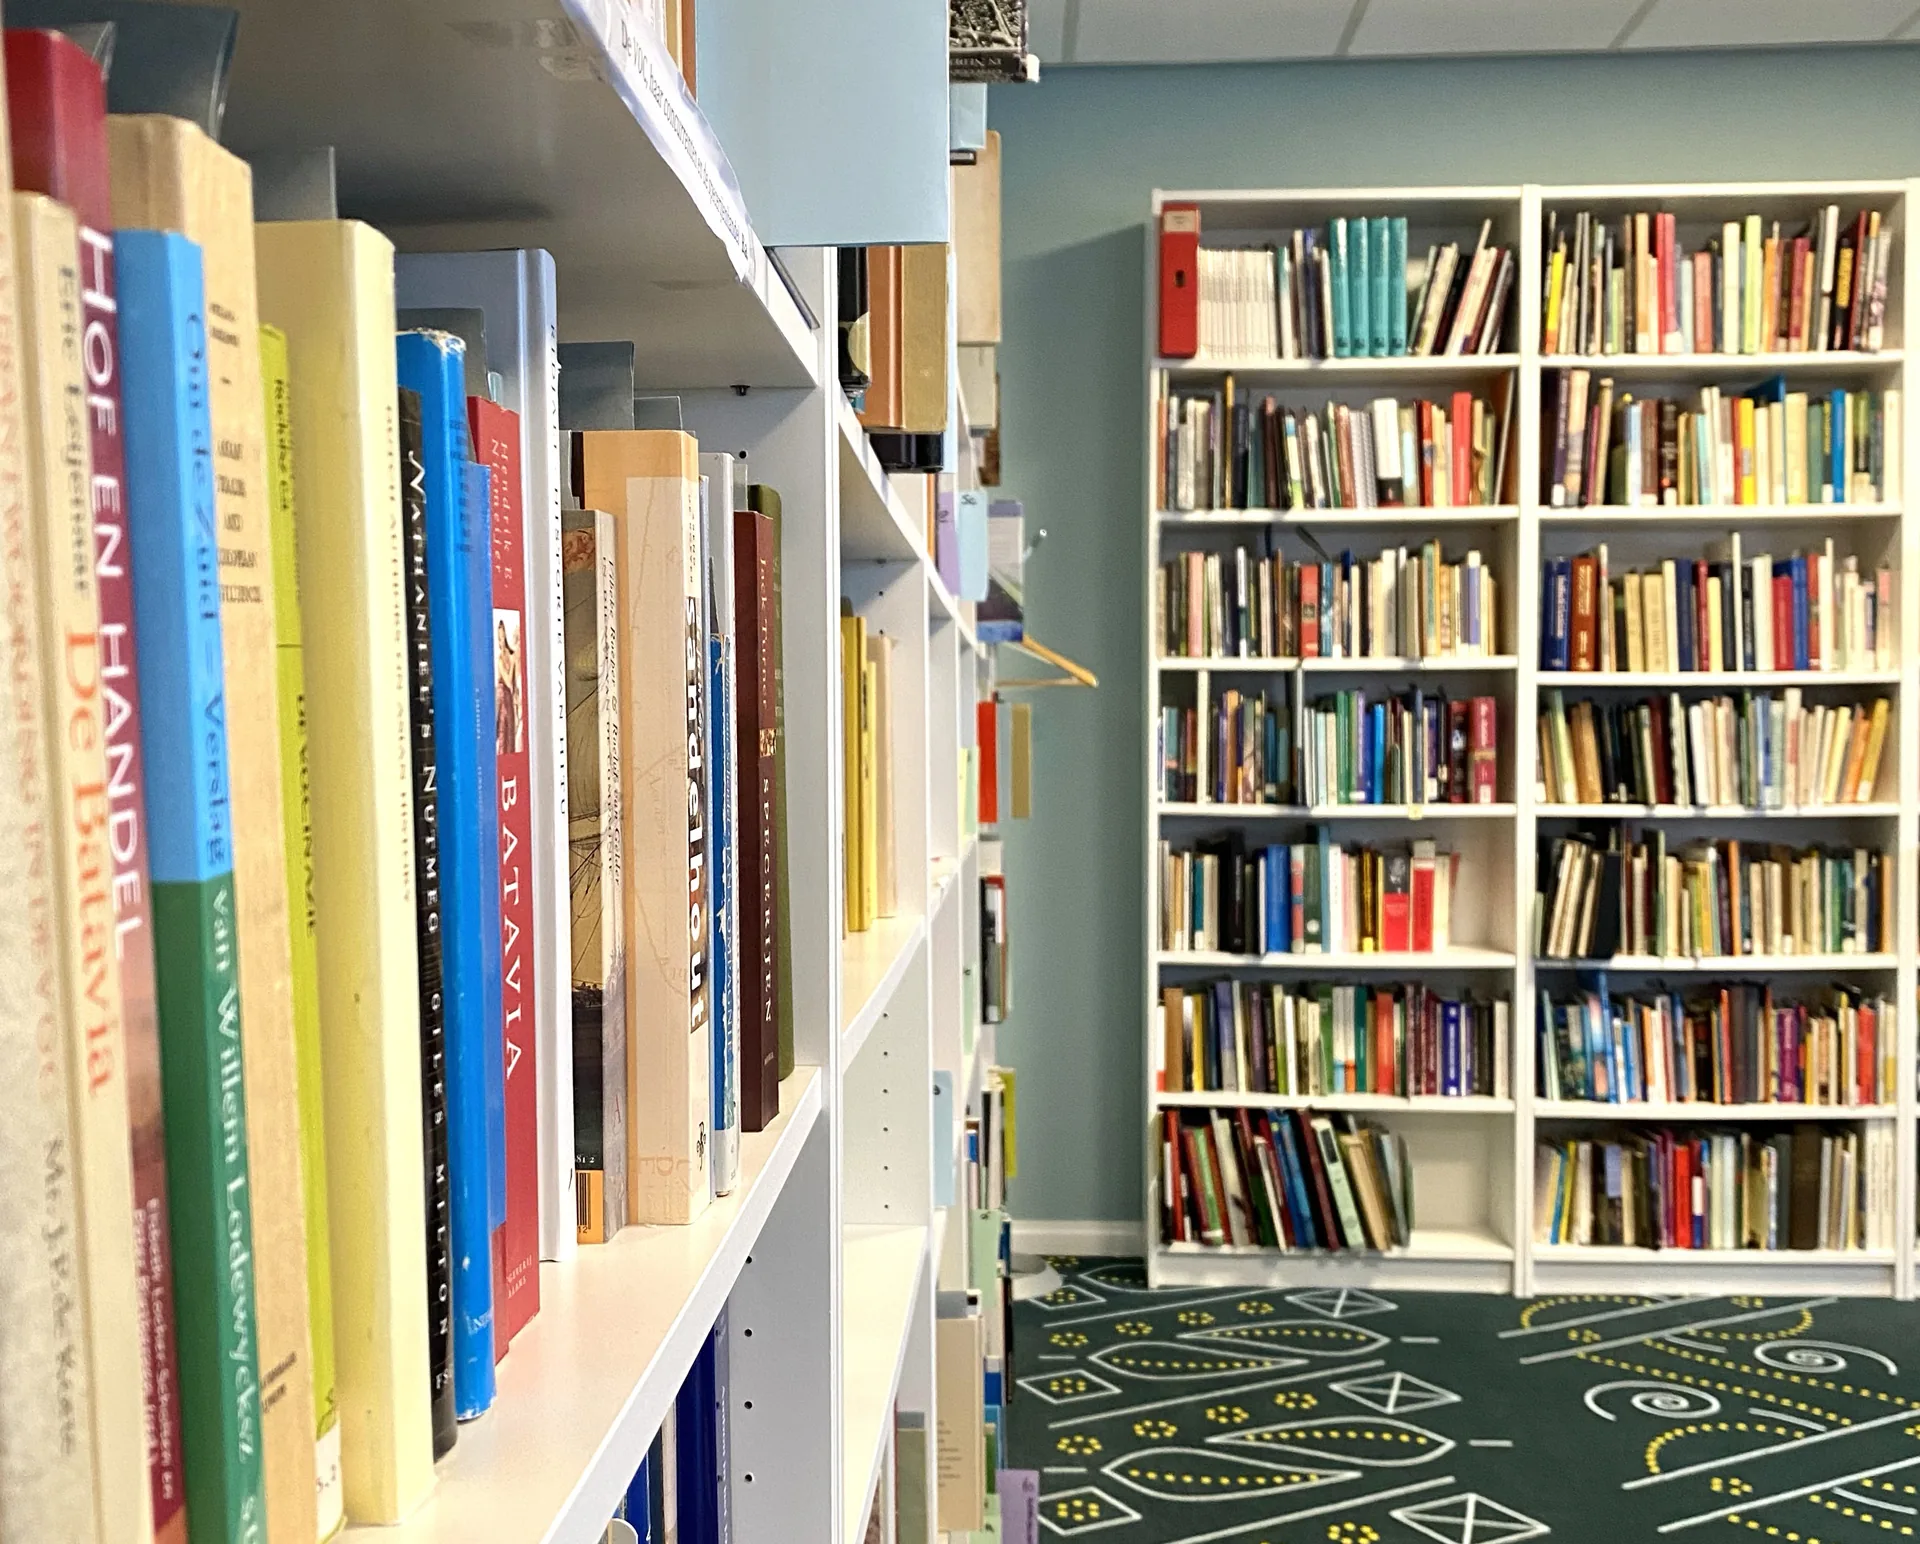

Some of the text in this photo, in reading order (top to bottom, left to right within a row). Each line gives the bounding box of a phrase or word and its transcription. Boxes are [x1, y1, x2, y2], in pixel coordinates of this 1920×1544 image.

[621, 19, 631, 56] De
[664, 98, 698, 168] concurrenten
[500, 442, 514, 552] Hendrik
[759, 558, 767, 610] Jack
[79, 226, 143, 960] HOF EN HANDEL
[64, 632, 98, 752] De
[557, 660, 565, 719] VAN
[204, 691, 229, 867] Verslag
[685, 597, 704, 1028] sandelhout
[72, 778, 117, 1096] Batavia
[213, 888, 230, 972] van
[408, 450, 448, 1336] NATHANIEL'S NUTMEG GILES MILTON
[501, 775, 522, 1080] BATAVIA
[218, 984, 241, 1164] Willem
